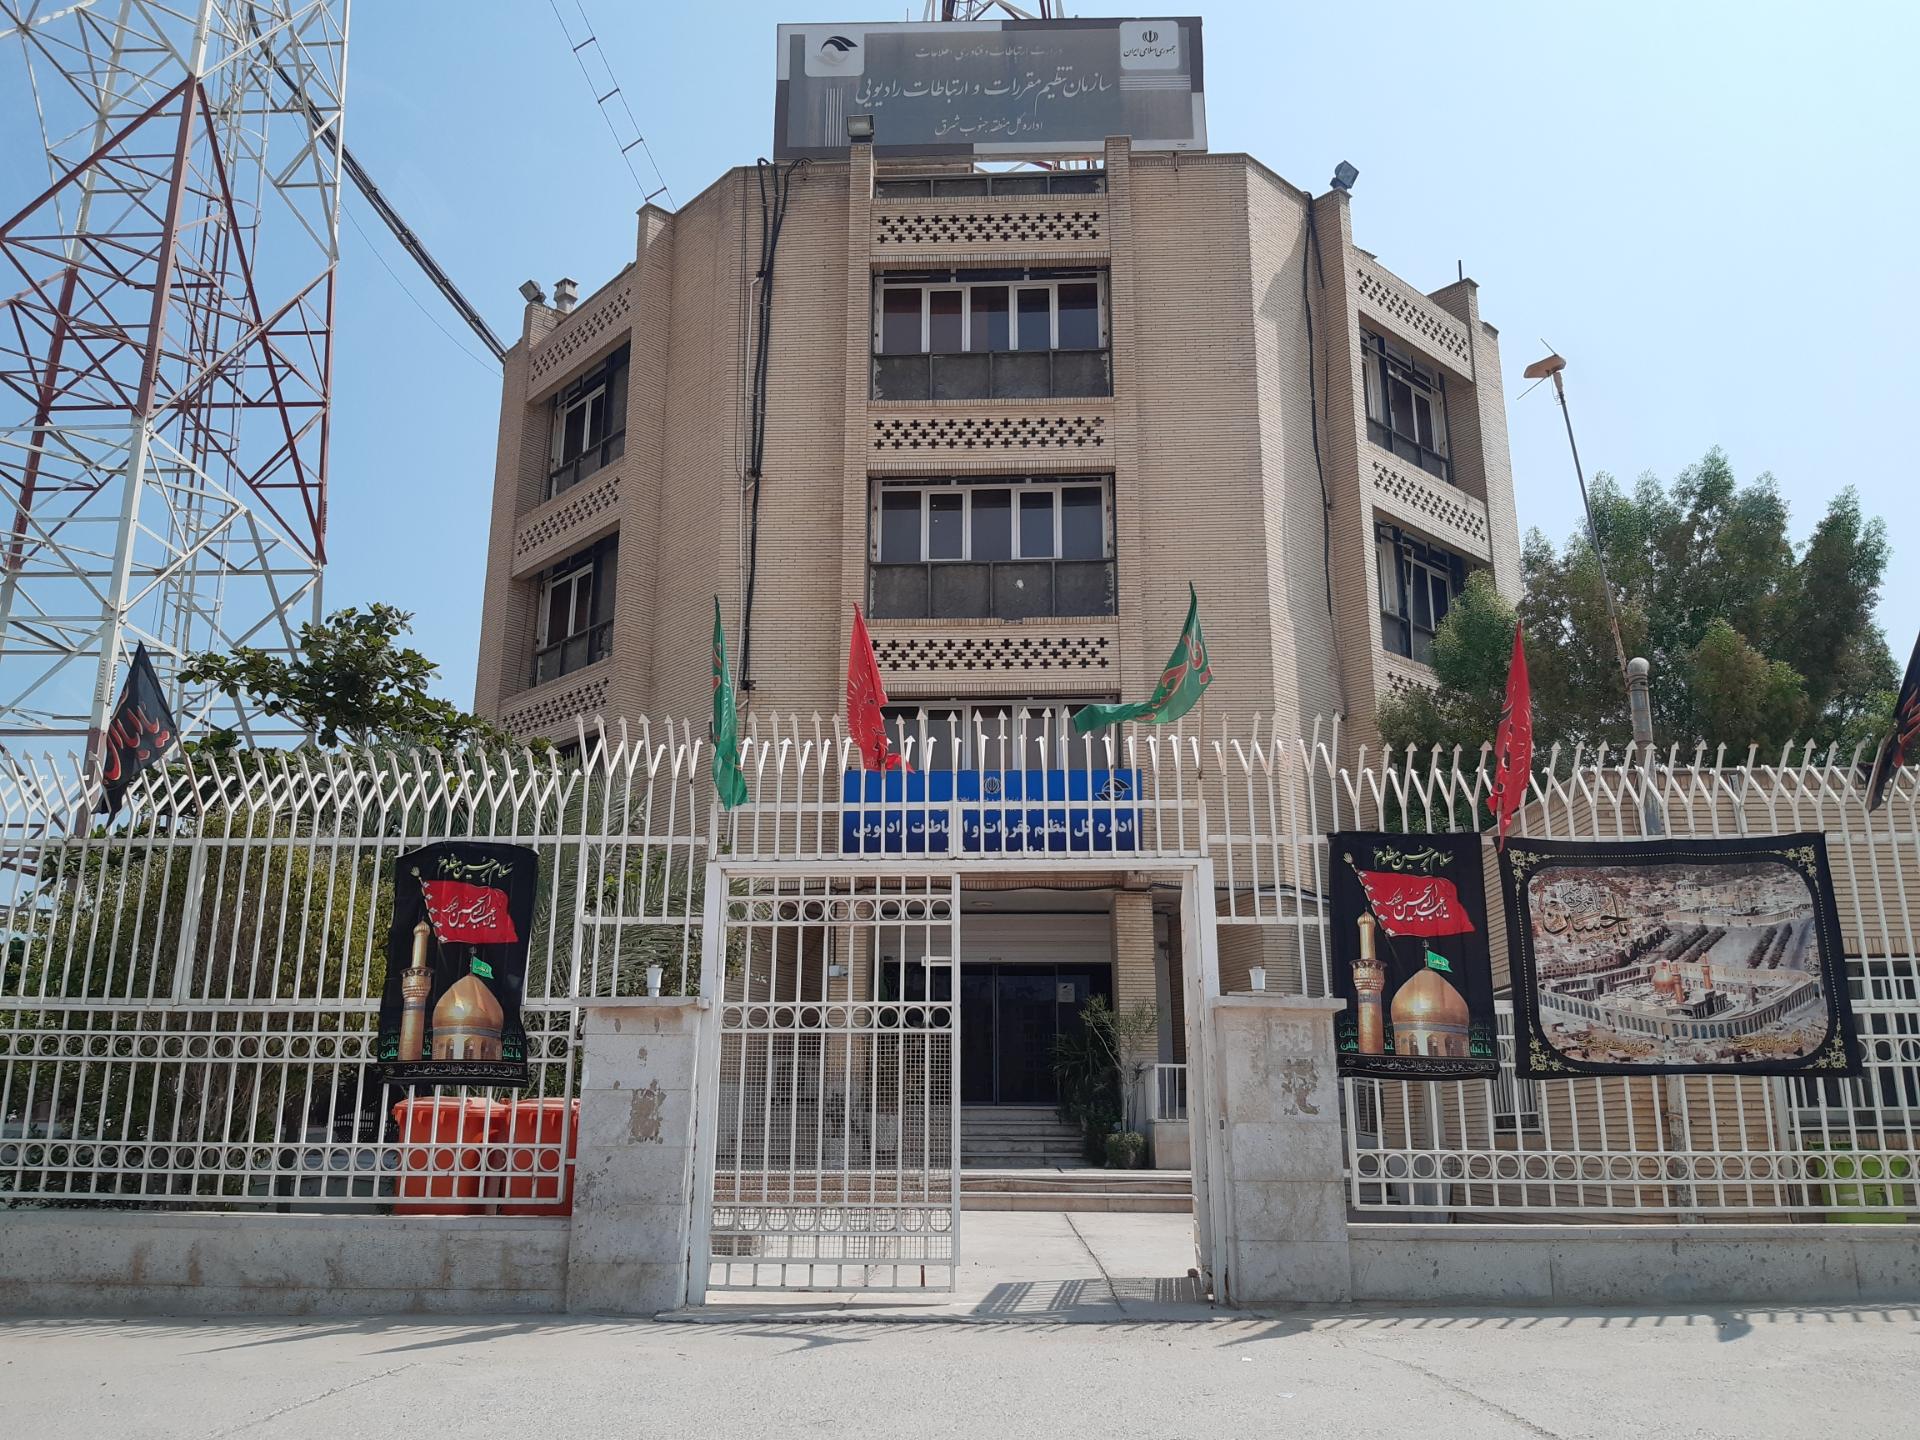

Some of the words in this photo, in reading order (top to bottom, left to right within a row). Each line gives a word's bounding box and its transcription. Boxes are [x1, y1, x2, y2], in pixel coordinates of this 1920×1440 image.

[1123, 47, 1139, 57] ایران
[1139, 46, 1157, 57] اسلامی
[903, 78, 969, 104] ارتباطات
[971, 83, 980, 95] و
[984, 71, 1042, 100] مقررات
[1034, 65, 1073, 118] تنظیم
[1063, 72, 1113, 98] سازمان
[935, 114, 961, 135] شرق
[960, 116, 989, 137] جنوب
[989, 117, 1011, 132] منطقه
[971, 824, 980, 838] و
[453, 858, 497, 879] حسین
[1392, 846, 1435, 870] حسین
